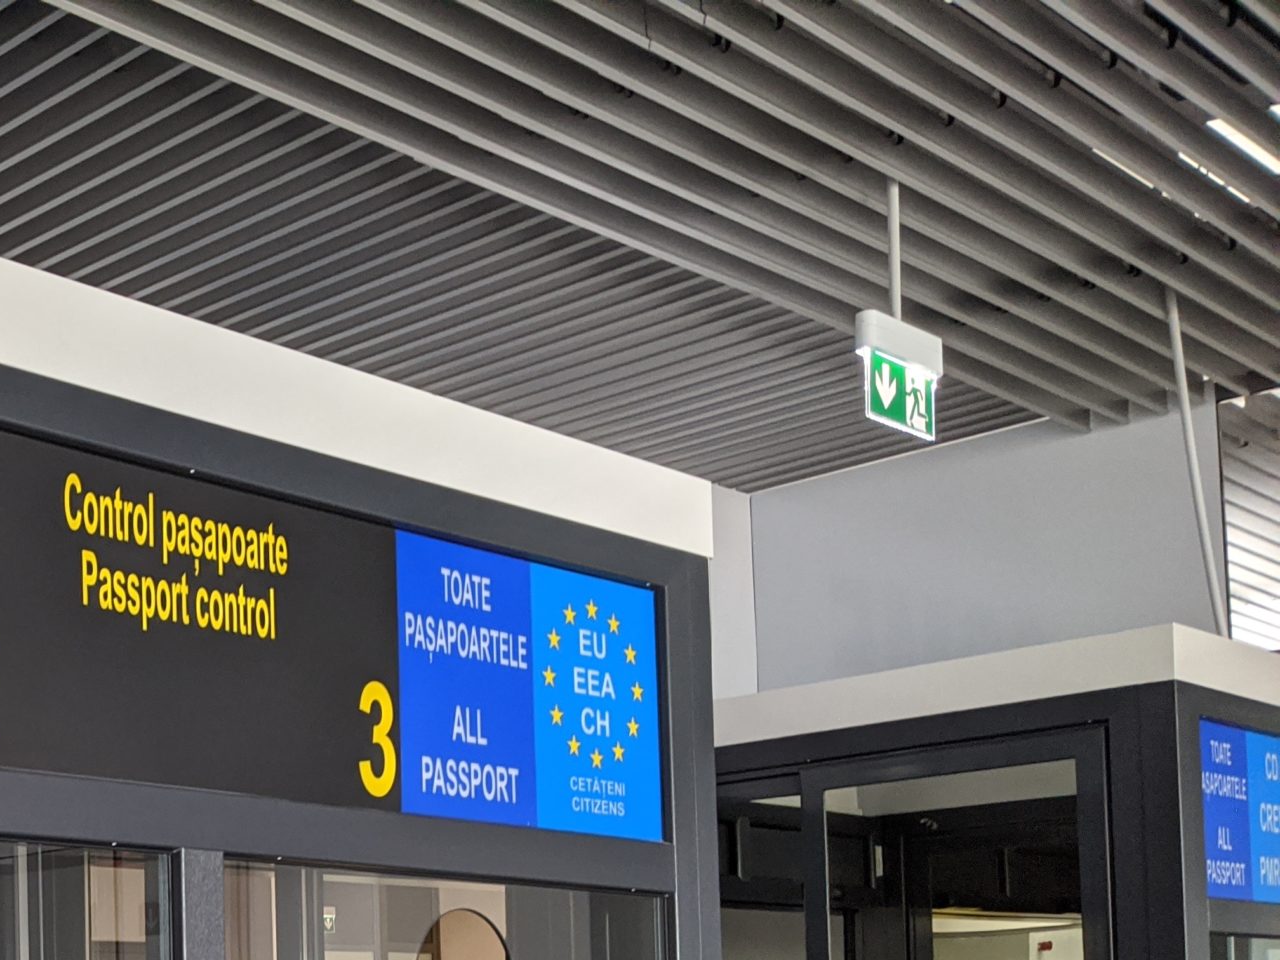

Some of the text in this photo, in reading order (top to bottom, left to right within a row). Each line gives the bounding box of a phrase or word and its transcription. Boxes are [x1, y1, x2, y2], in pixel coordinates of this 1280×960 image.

[63, 472, 288, 576] Control pașapoarte
[81, 549, 275, 640] Passport control
[441, 566, 491, 612] TOATE
[405, 613, 528, 670] PAȘAPOARTELE
[579, 628, 607, 660] EU
[573, 666, 616, 700] EEA
[358, 680, 397, 798] 3
[452, 704, 488, 746] ALL
[581, 706, 611, 738] CH
[1209, 740, 1232, 766] TOATE
[421, 754, 519, 804] PASSPORT
[572, 796, 625, 817] CITIZENS
[1217, 826, 1232, 851] ALL
[1206, 859, 1246, 886] PASSPORT
